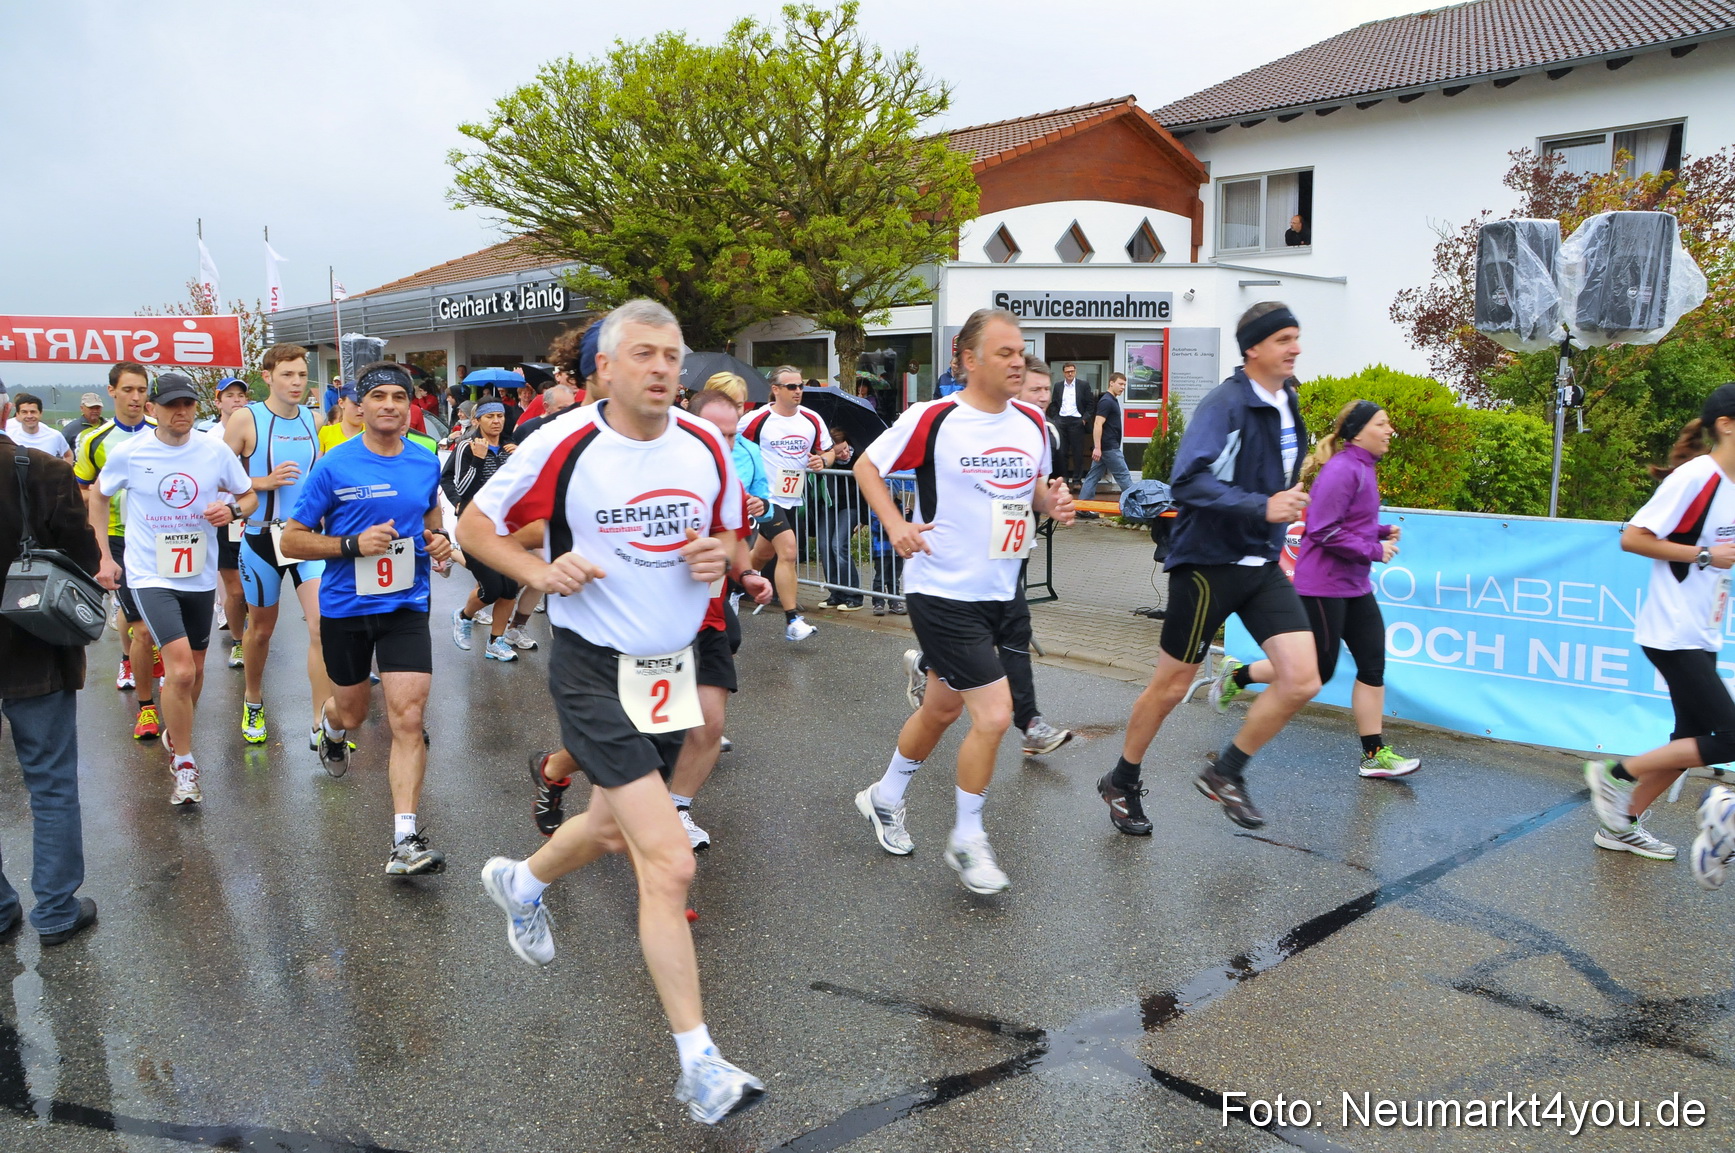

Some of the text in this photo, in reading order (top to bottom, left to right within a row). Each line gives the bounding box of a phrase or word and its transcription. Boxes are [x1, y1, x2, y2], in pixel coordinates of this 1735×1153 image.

[440, 282, 565, 320] Gerhart & Jänig
[995, 292, 1170, 318] Serviceannahme
[960, 457, 1023, 468] GERHART
[783, 477, 799, 494] 37
[145, 513, 173, 522] LAUFEN
[596, 503, 690, 525] GERHART
[1002, 519, 1026, 553] 79
[171, 547, 193, 574] 71
[376, 557, 393, 588] 9
[1435, 570, 1642, 627] HABEN
[1385, 621, 1630, 687] OCH NIE
[650, 679, 670, 725] 2
